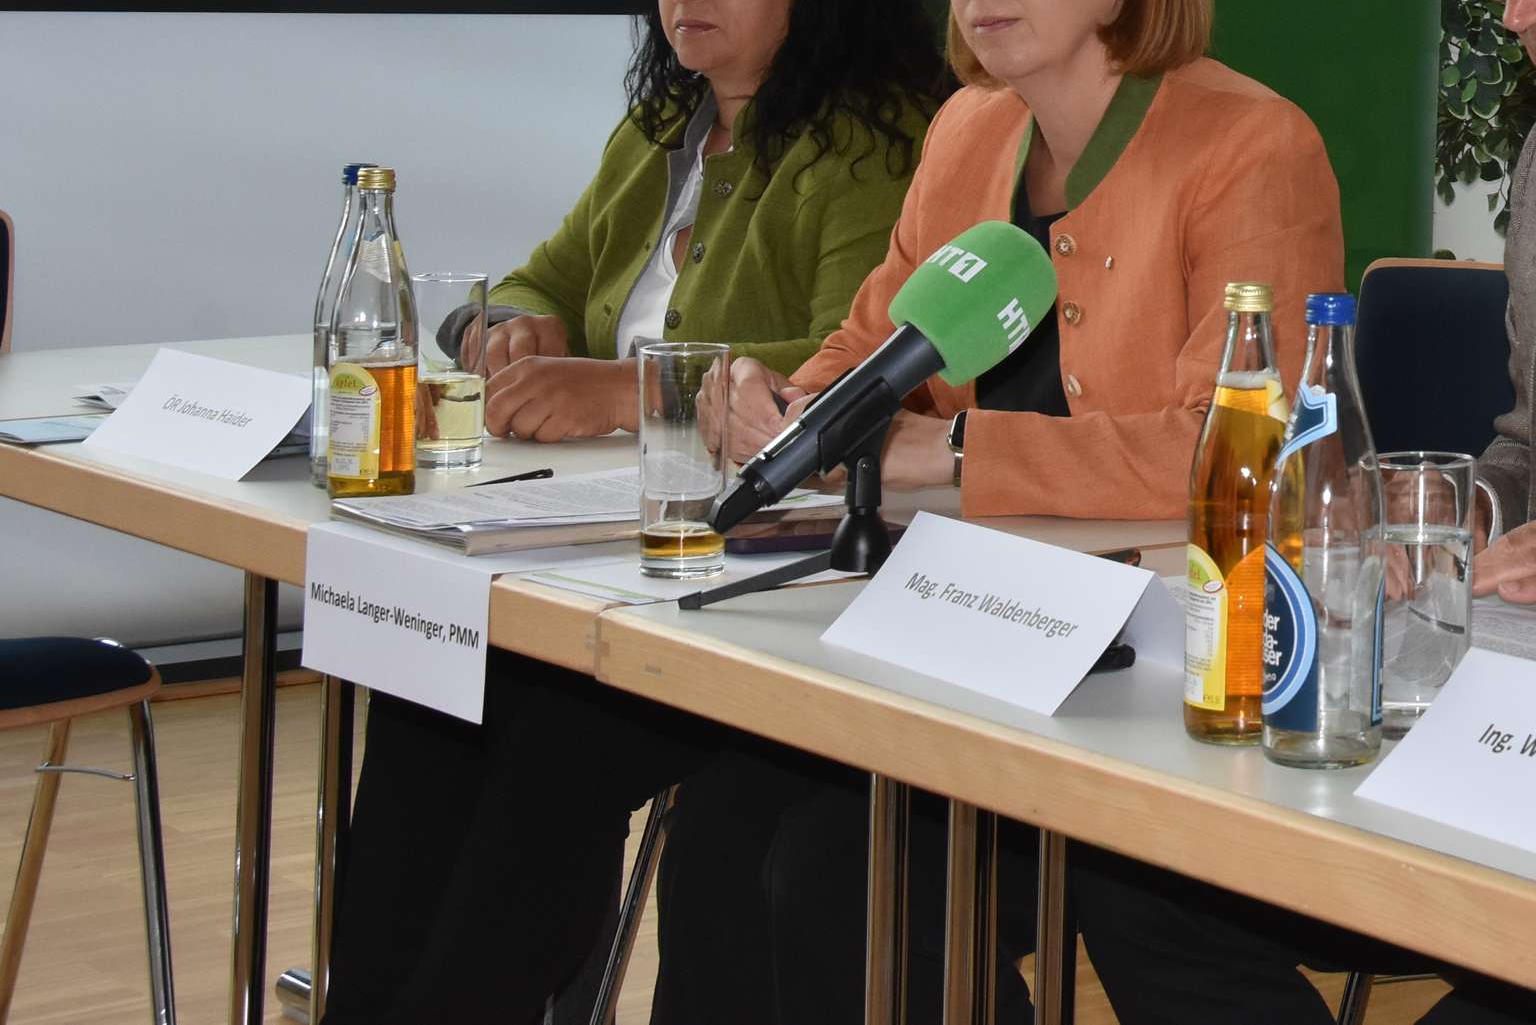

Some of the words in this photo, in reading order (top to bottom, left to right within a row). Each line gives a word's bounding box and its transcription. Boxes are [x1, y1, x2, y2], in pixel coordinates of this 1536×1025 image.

[996, 297, 1031, 355] HT
[176, 399, 220, 421] Johanna
[215, 409, 253, 428] Haider
[310, 581, 355, 612] Michaela
[357, 595, 446, 643] Langer-Weninger,
[448, 623, 480, 650] PMM
[904, 571, 940, 601] Mag.
[938, 582, 979, 609] Franz
[977, 592, 1080, 639] Waldenberger
[1477, 722, 1515, 754] Ing.
